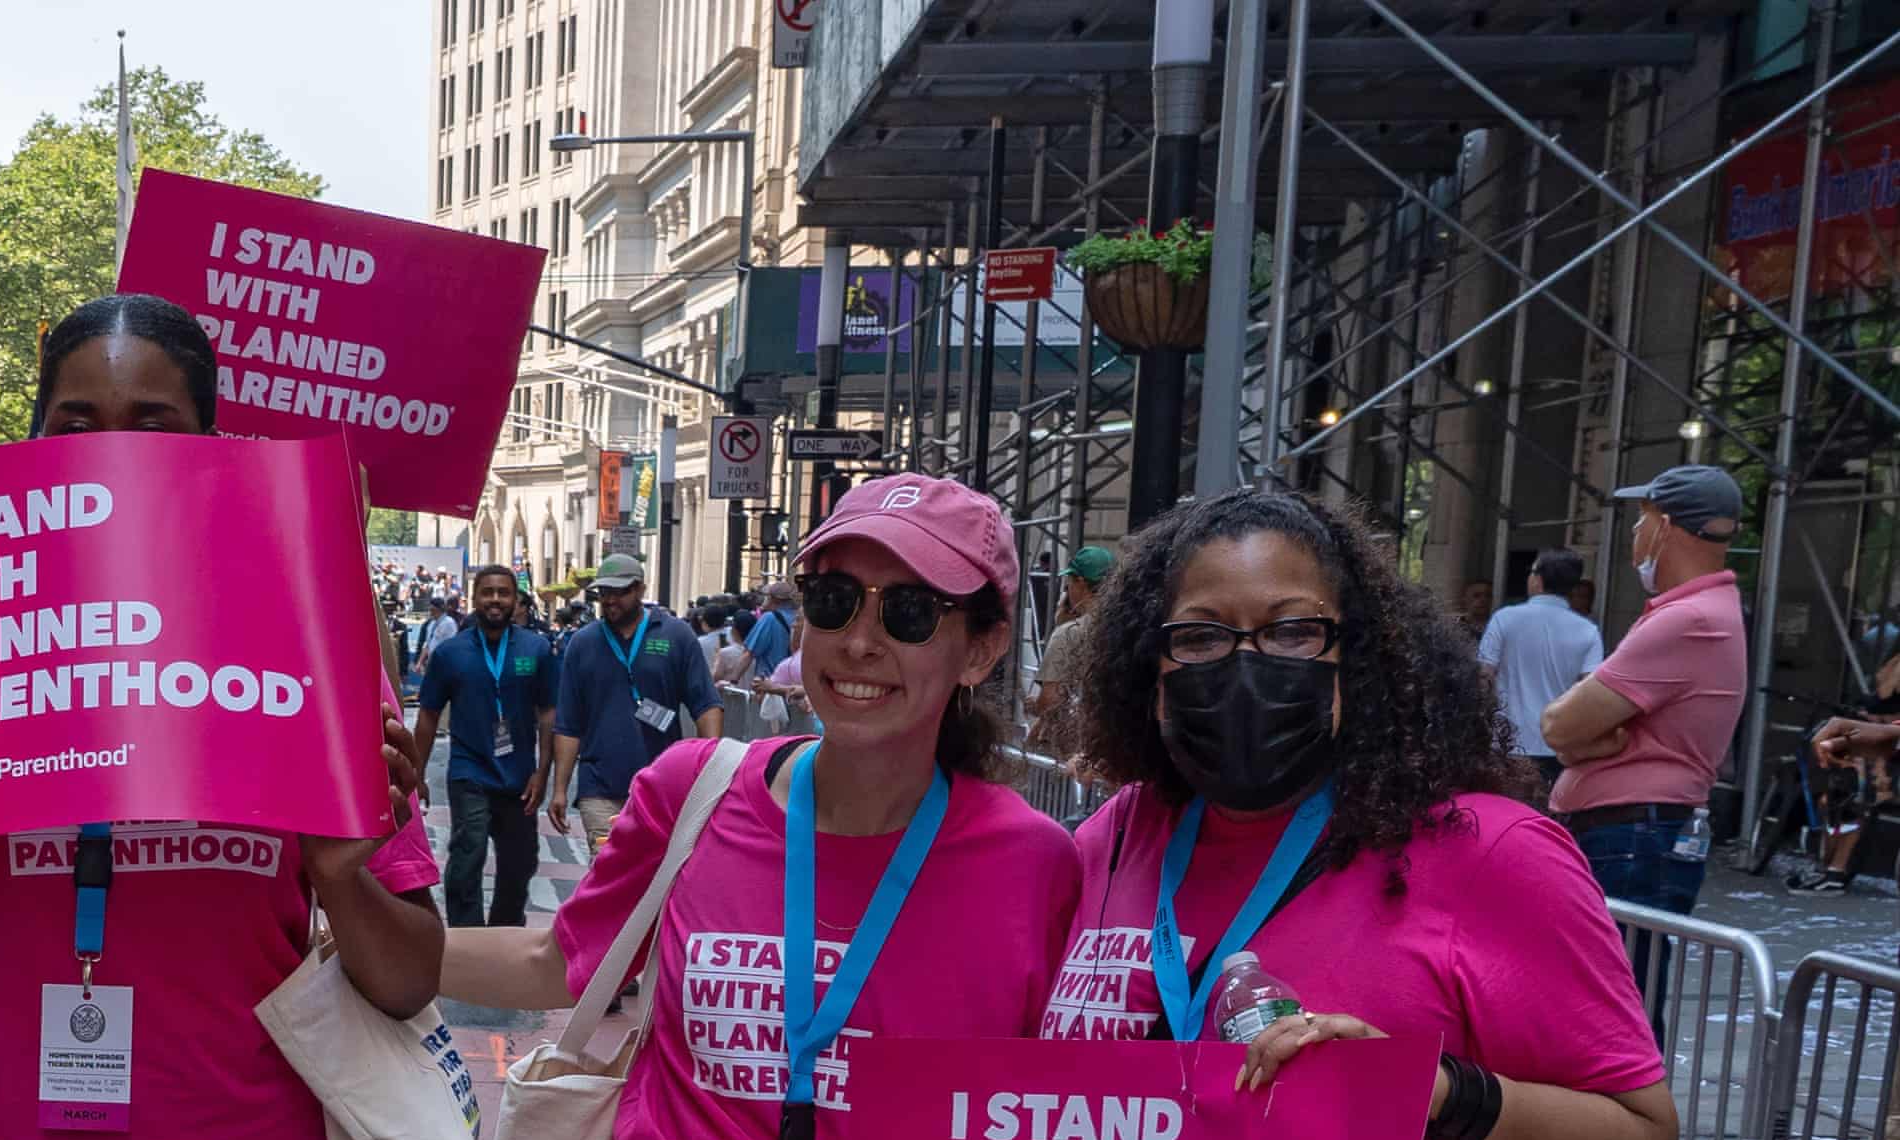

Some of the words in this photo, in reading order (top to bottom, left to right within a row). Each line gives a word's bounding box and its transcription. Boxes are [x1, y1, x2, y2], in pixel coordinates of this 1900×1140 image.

[210, 222, 227, 258] I
[235, 228, 375, 285] STAND
[1003, 254, 1044, 265] STANDING
[206, 269, 319, 323] WITH
[844, 326, 885, 336] itness
[846, 314, 878, 325] lanet
[196, 314, 386, 381] PLANNED
[217, 366, 450, 437] ARENTHOOD
[797, 440, 825, 449] ONE
[841, 440, 870, 451] WAY
[717, 482, 759, 493] TRUCKS
[728, 467, 749, 478] FOR
[691, 939, 701, 965] I
[710, 939, 843, 975] STAD
[1071, 935, 1087, 961] I
[1087, 933, 1152, 963] STAN
[689, 978, 785, 1013] WITH
[1057, 970, 1123, 1003] WITH
[63, 1109, 108, 1120] MARCH
[951, 1092, 969, 1140] I
